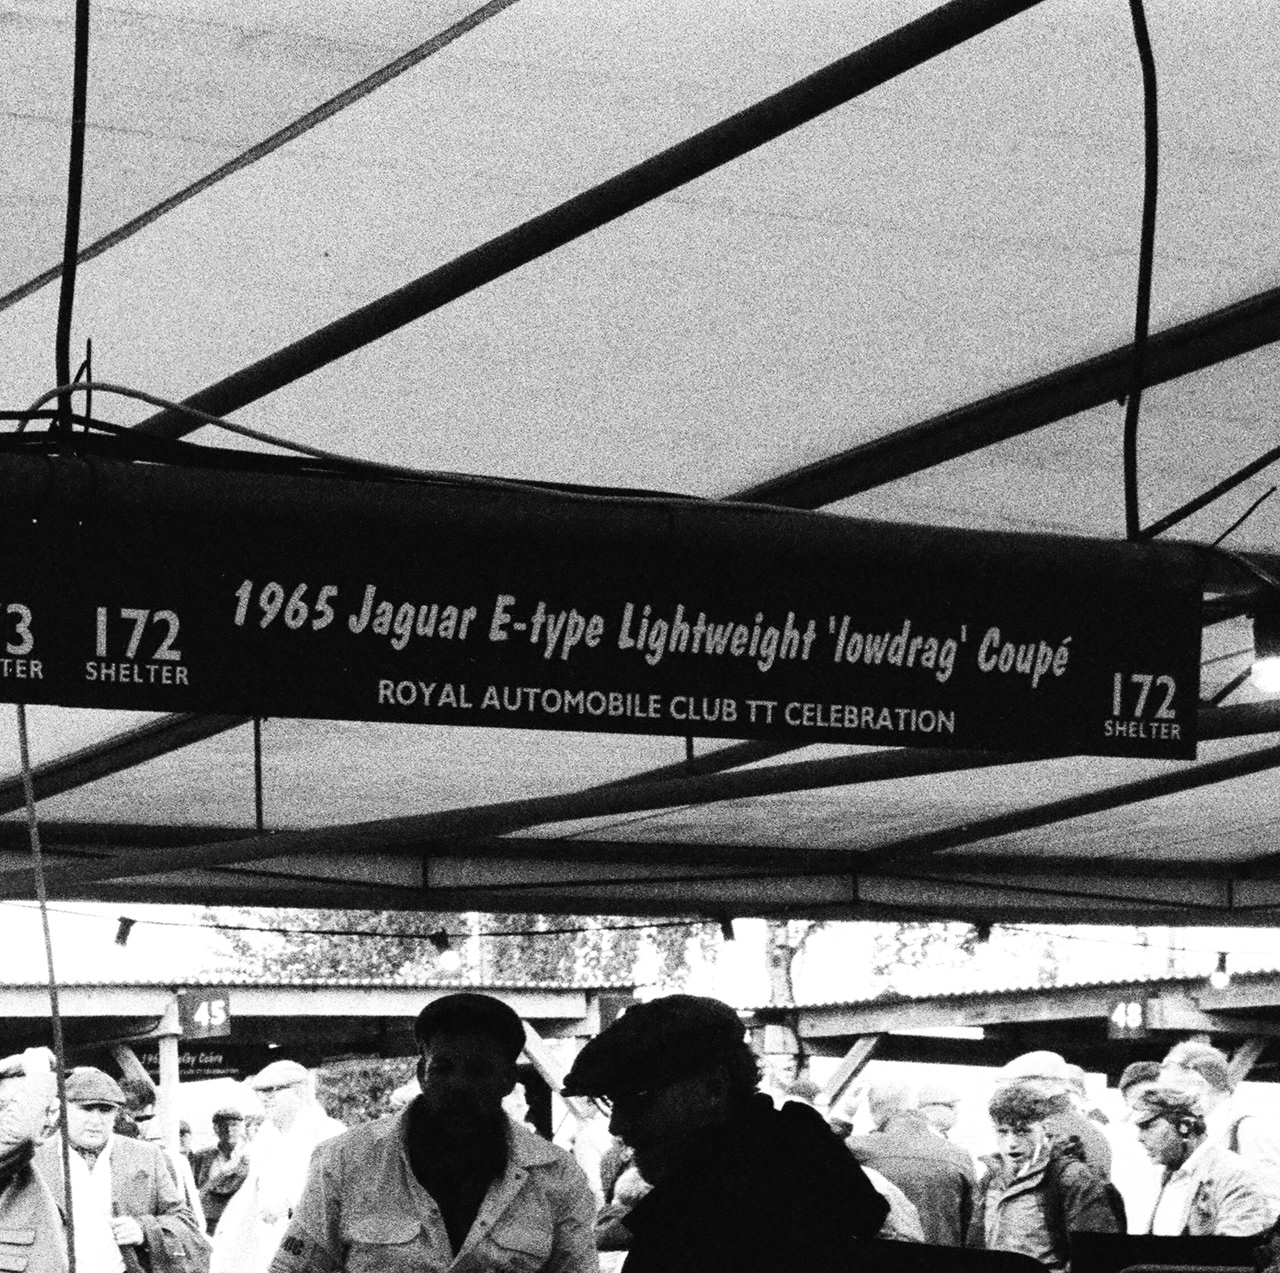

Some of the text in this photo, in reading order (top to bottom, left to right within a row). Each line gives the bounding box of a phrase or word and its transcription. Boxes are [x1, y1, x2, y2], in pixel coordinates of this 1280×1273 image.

[96, 607, 181, 661] 172
[235, 580, 1071, 688] 1965 Jaguar E-type Lightweight 'lowdrag' Coupé
[86, 662, 188, 684] SHELTER
[379, 680, 954, 732] ROYAL AUTOMOBILE CLUB TT CELEBRATION
[1113, 673, 1175, 719] 172
[1105, 720, 1179, 738] SHELTER
[194, 1000, 226, 1026] 45
[1112, 1002, 1142, 1028] 48
